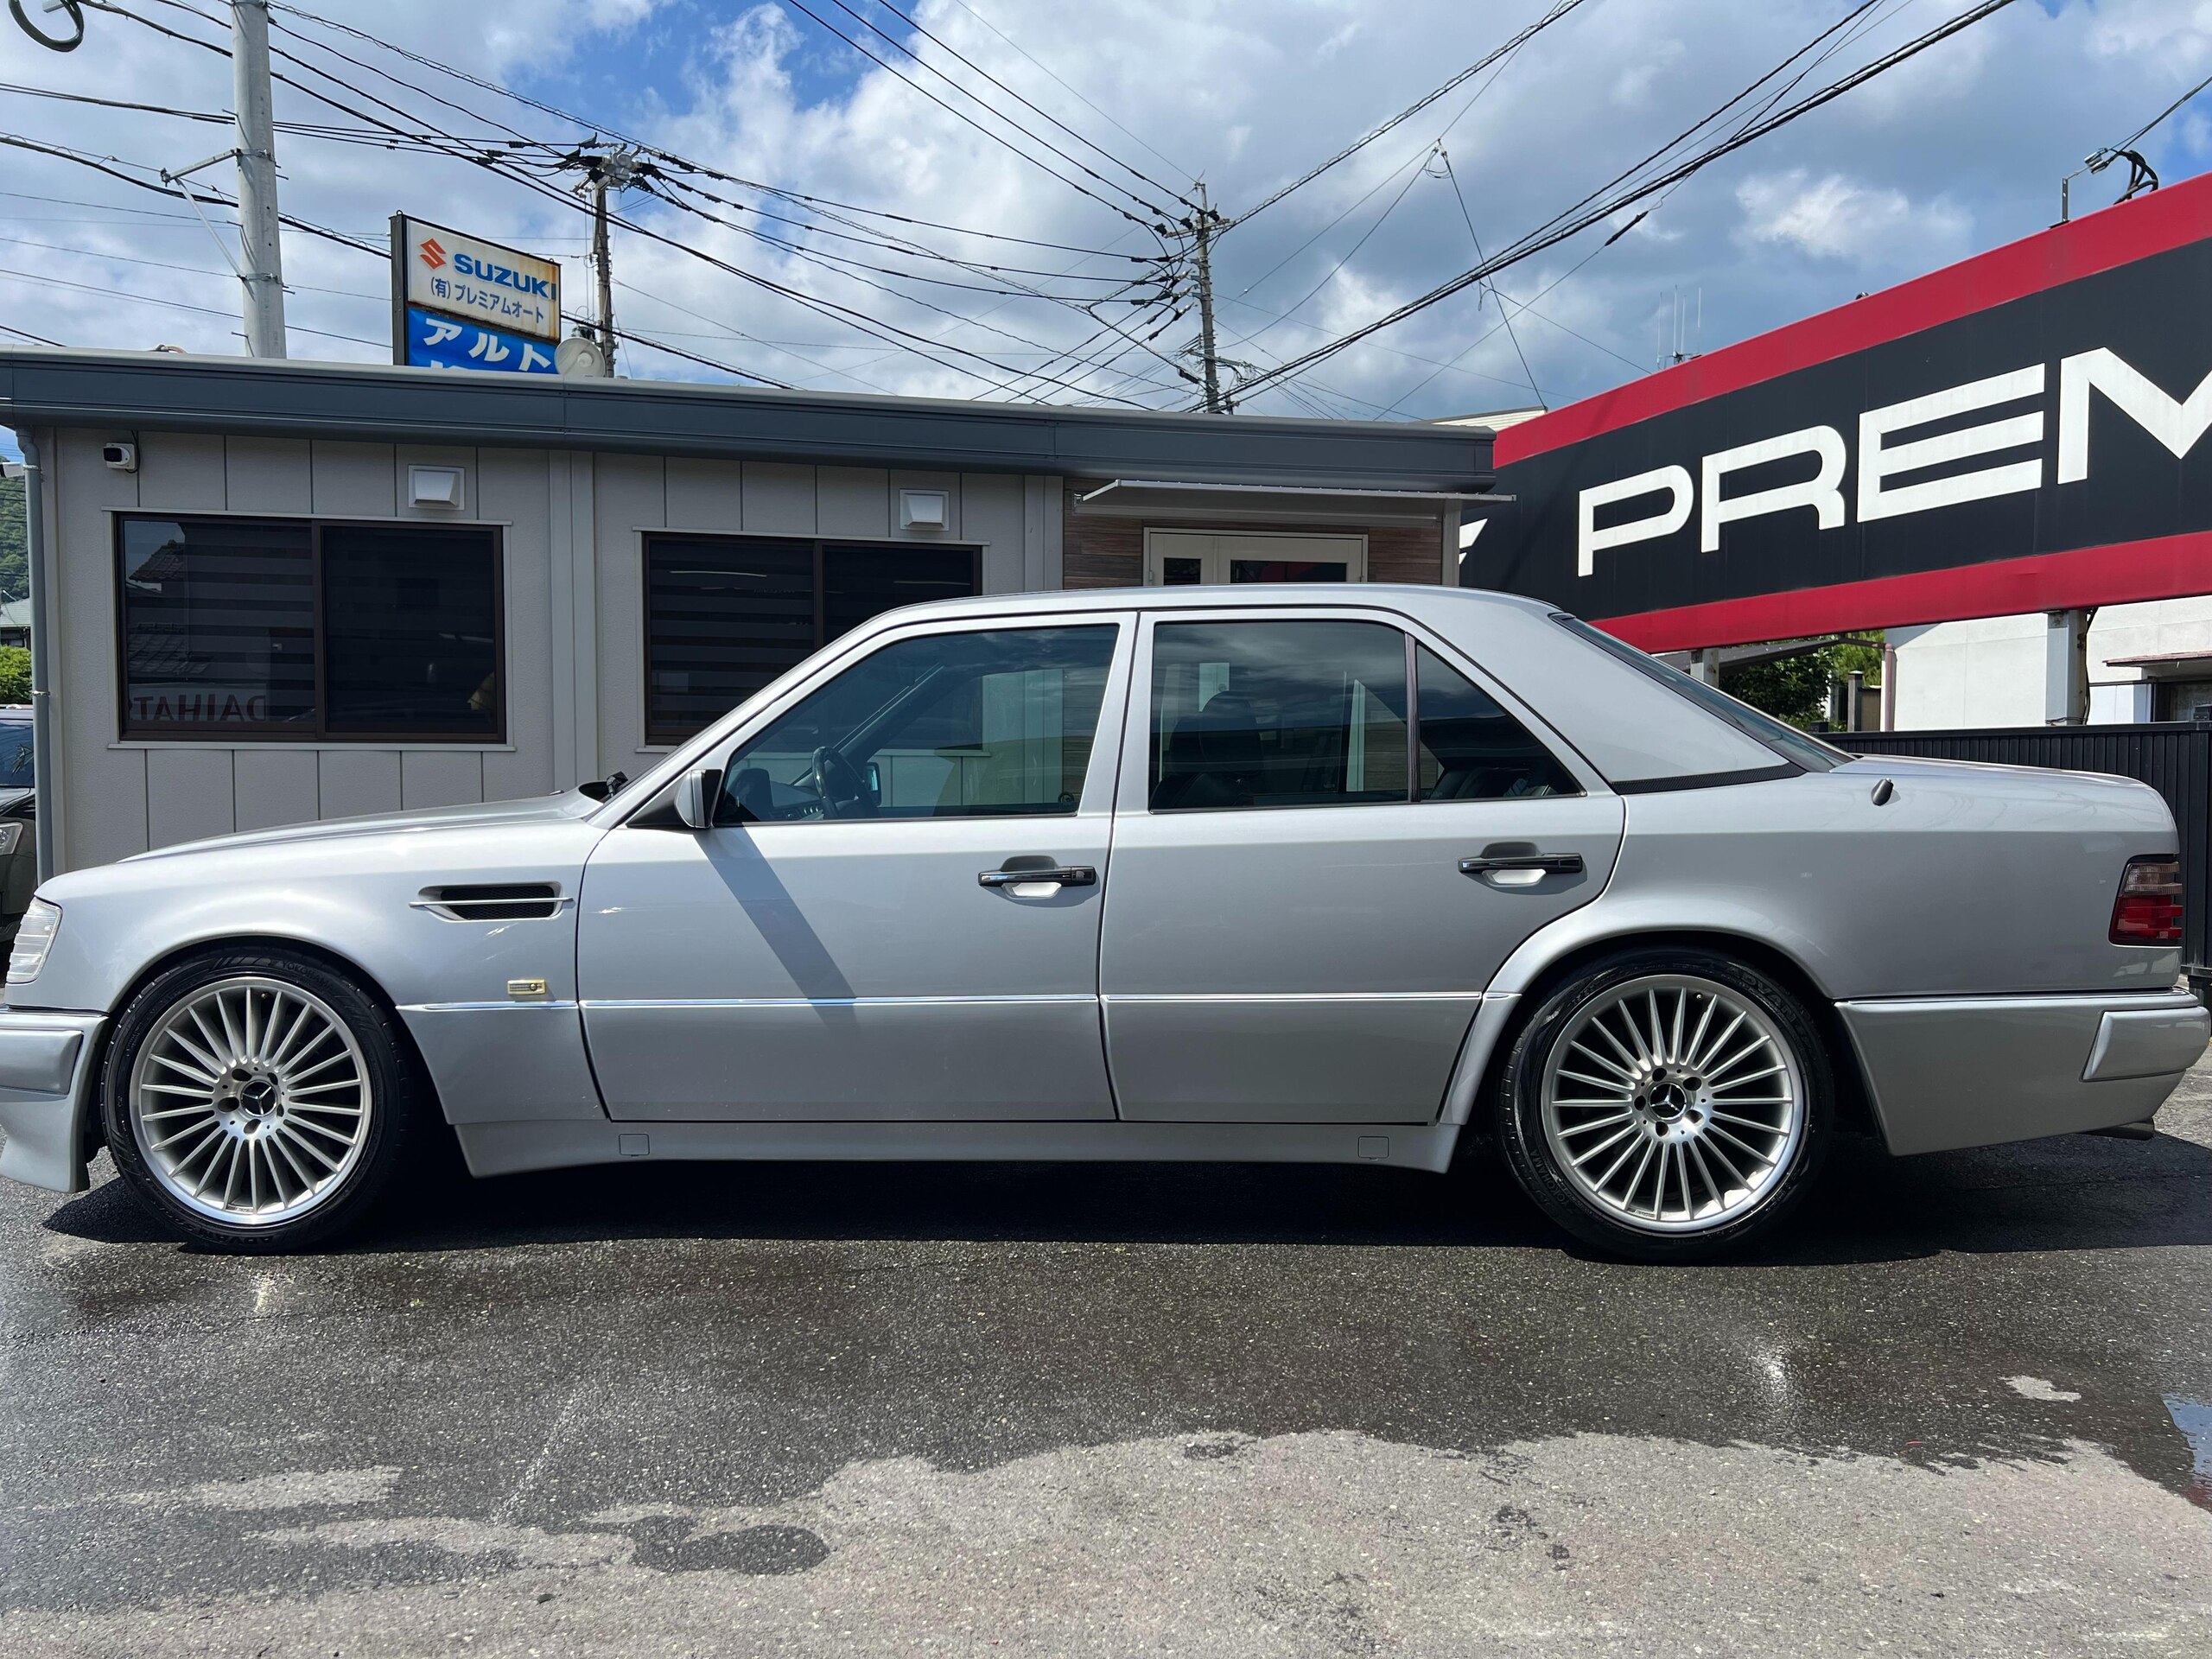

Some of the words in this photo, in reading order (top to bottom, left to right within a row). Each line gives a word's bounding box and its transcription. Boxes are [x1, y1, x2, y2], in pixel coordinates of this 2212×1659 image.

[454, 253, 556, 301] SUZUKI
[423, 317, 551, 372] アルト
[282, 960, 334, 992] YOKOHAMA
[1727, 965, 1797, 1024] ADVAN
[1529, 1149, 1571, 1208] YOKOHAMA
